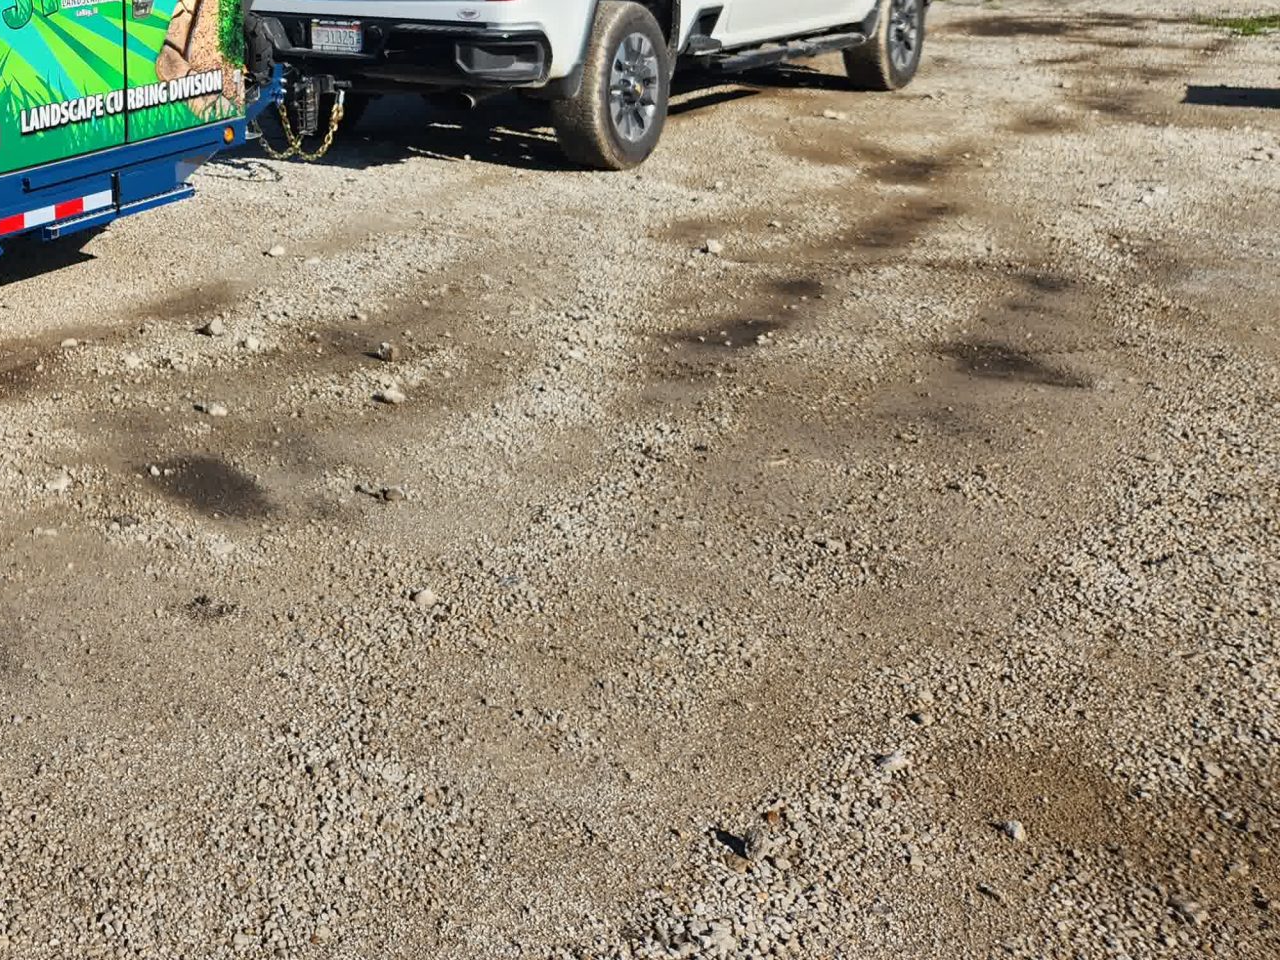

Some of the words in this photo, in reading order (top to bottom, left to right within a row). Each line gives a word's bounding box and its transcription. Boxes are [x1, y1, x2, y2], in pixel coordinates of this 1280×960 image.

[21, 93, 105, 134] LANDSCAPE
[105, 84, 169, 115] CURBING
[170, 69, 222, 102] DIVISION
